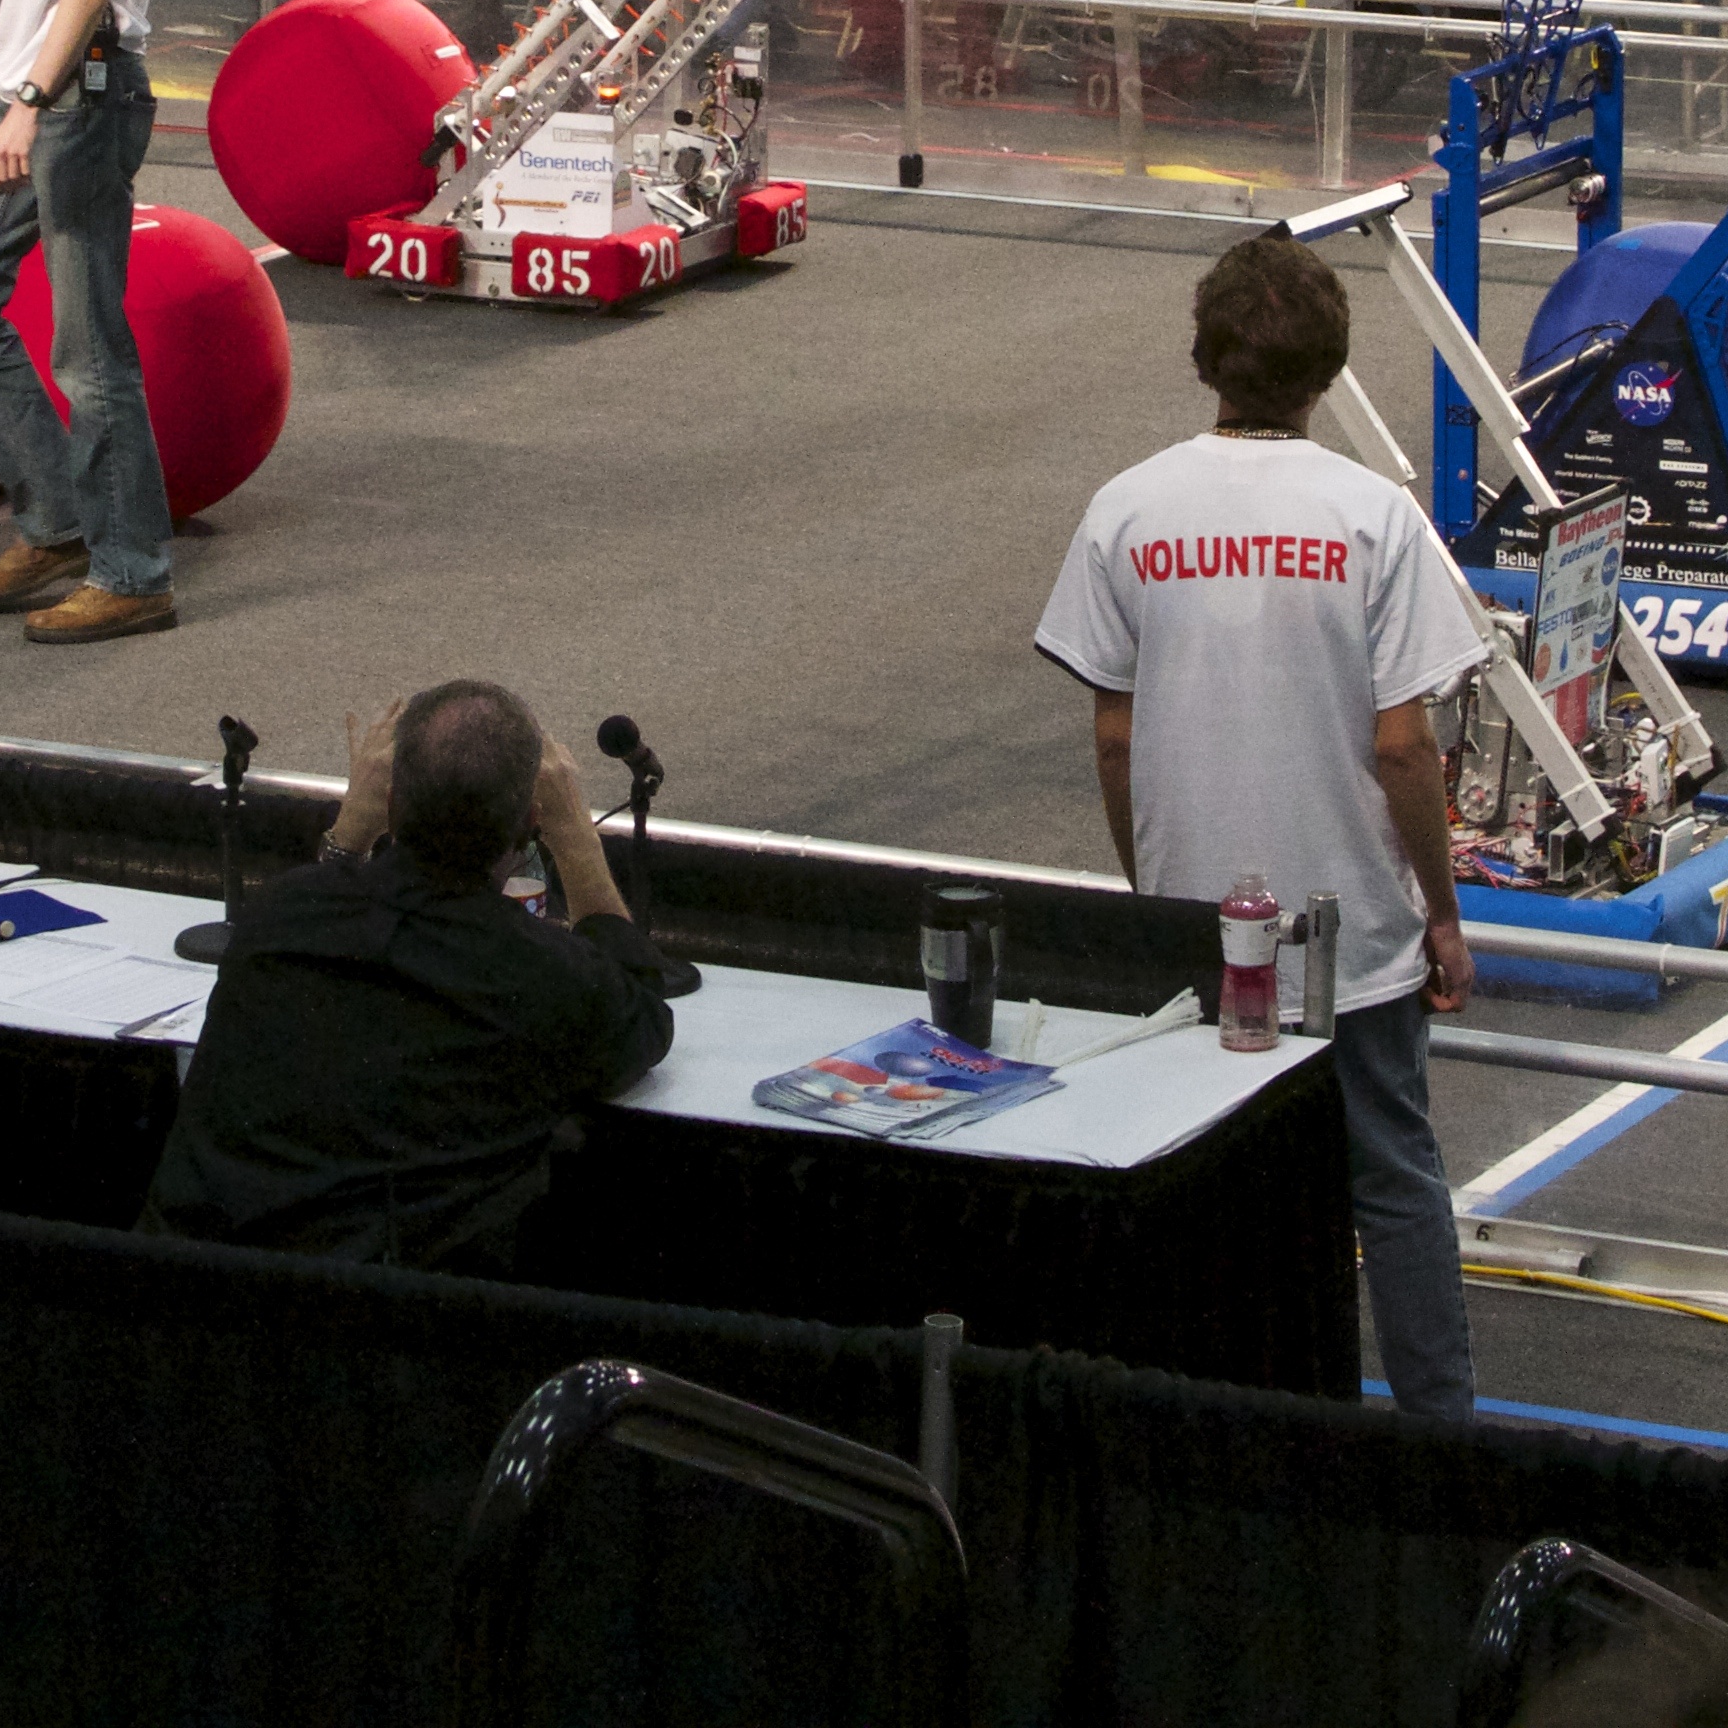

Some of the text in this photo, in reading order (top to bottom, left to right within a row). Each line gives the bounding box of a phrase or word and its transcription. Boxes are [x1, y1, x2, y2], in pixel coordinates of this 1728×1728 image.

[520, 150, 614, 172] Genentech
[775, 197, 807, 249] 85
[366, 231, 591, 295] 20 85
[639, 235, 676, 289] 20
[1619, 382, 1674, 406] NASA
[1557, 503, 1623, 547] Raytheon
[1129, 535, 1349, 585] VOLUNTEER
[1559, 535, 1606, 568] BOEING
[1667, 542, 1716, 555] MARTIN
